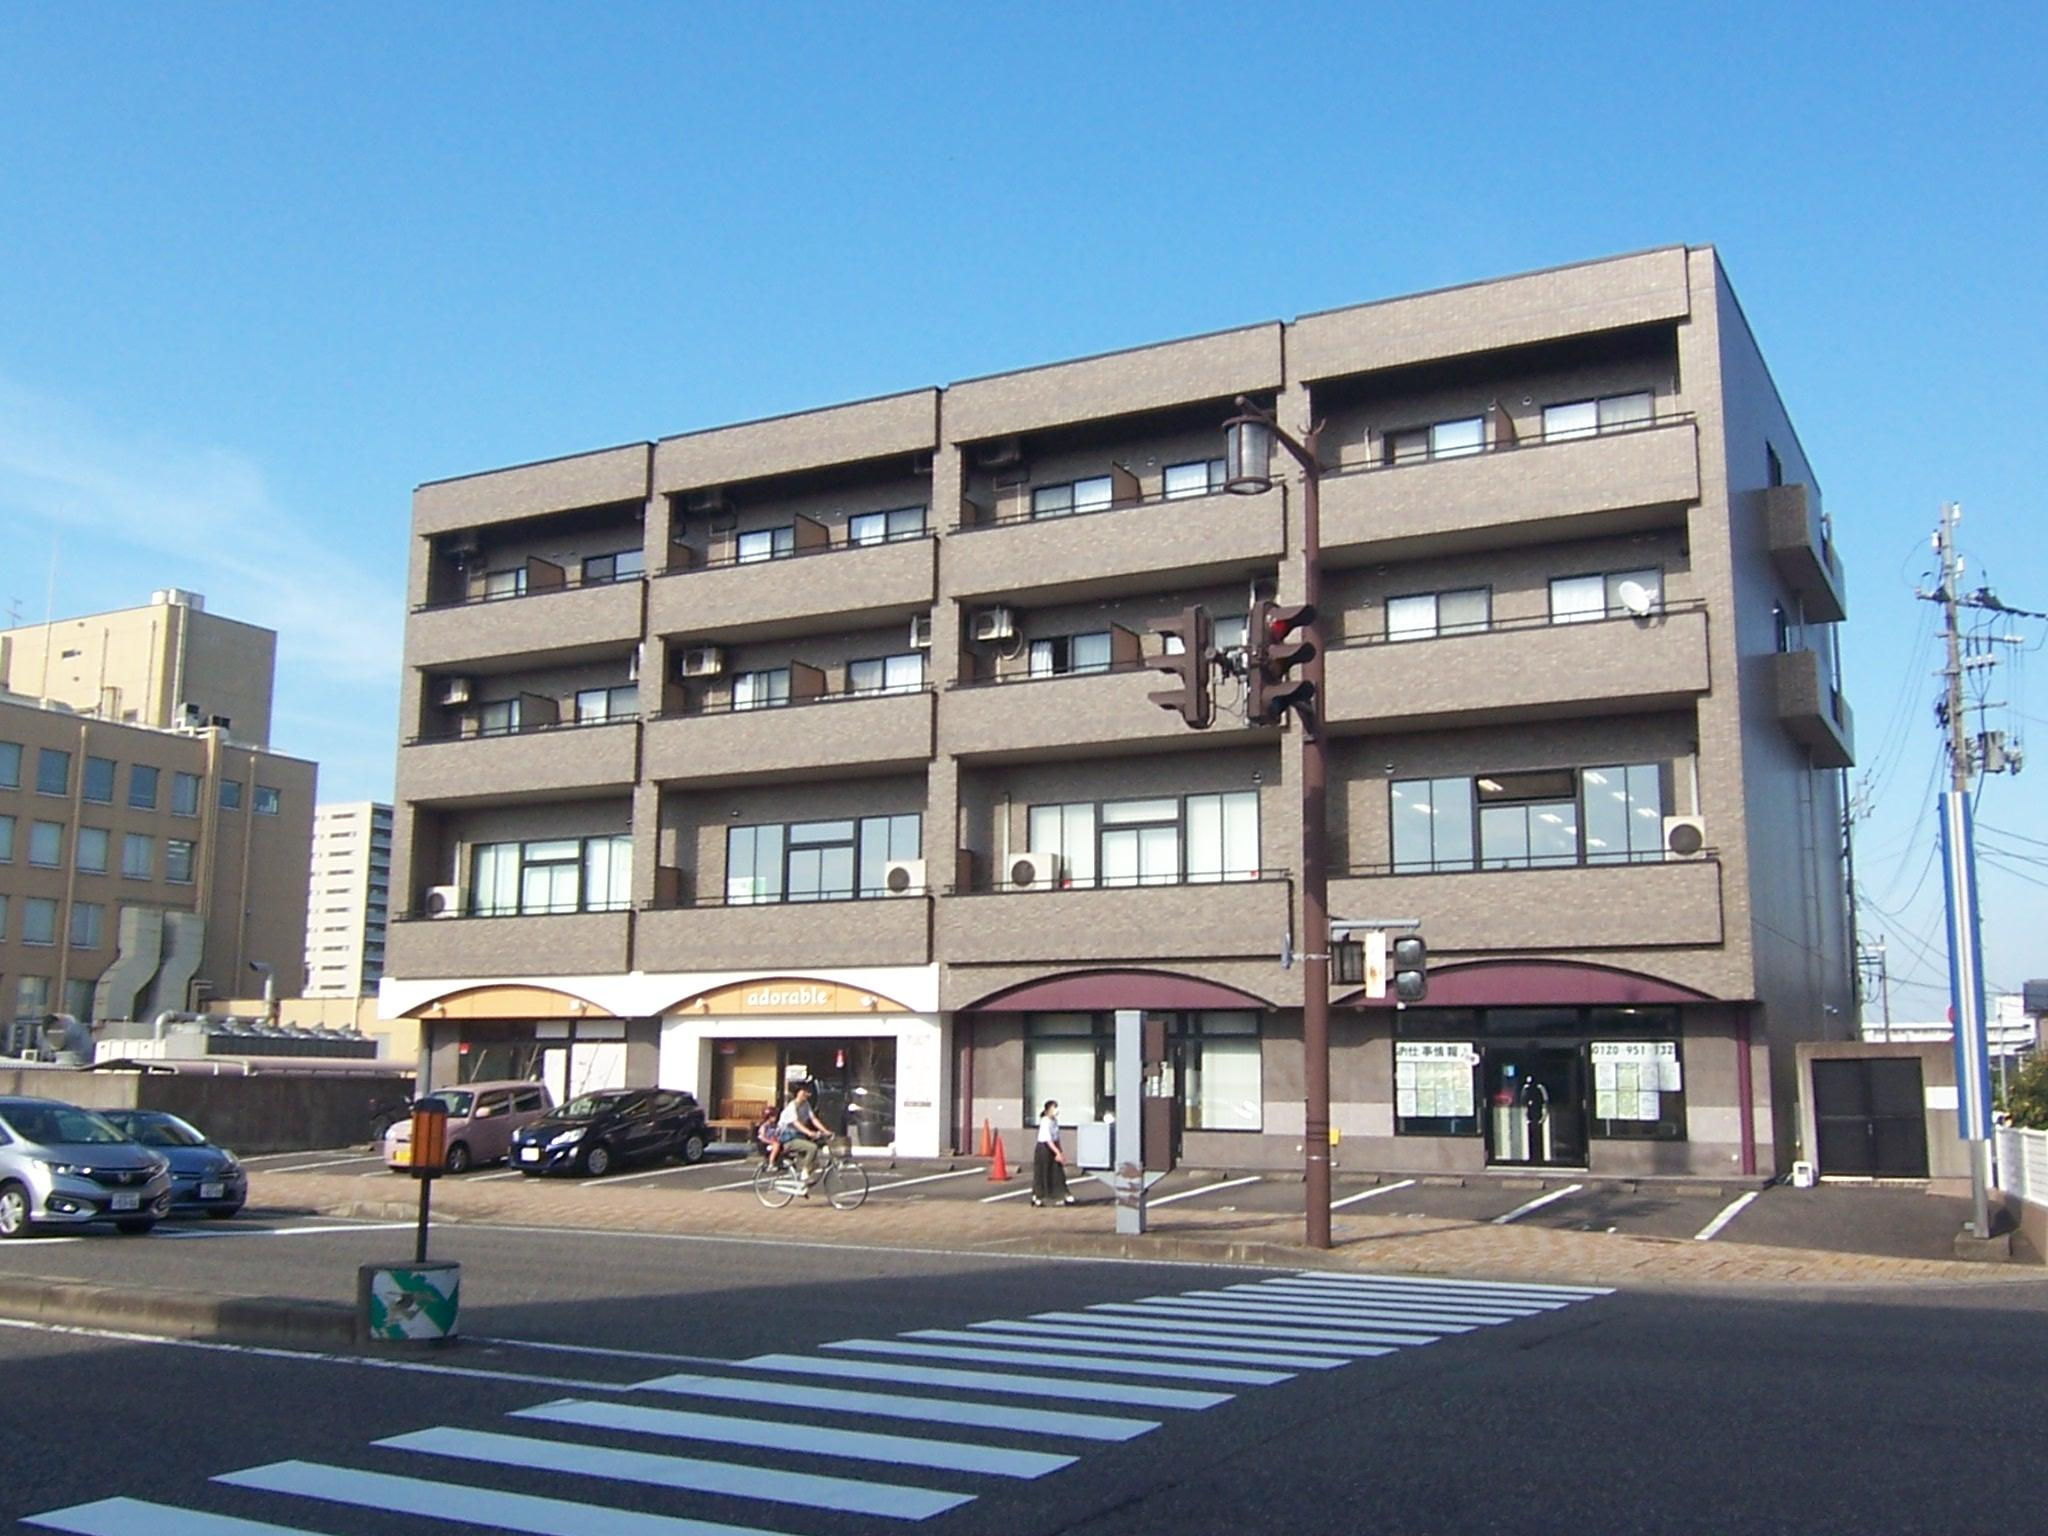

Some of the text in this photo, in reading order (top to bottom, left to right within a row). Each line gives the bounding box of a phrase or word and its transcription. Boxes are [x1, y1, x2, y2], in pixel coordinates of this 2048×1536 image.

[746, 985, 828, 1006] adorable
[1592, 1045, 1674, 1056] 0120 951 132
